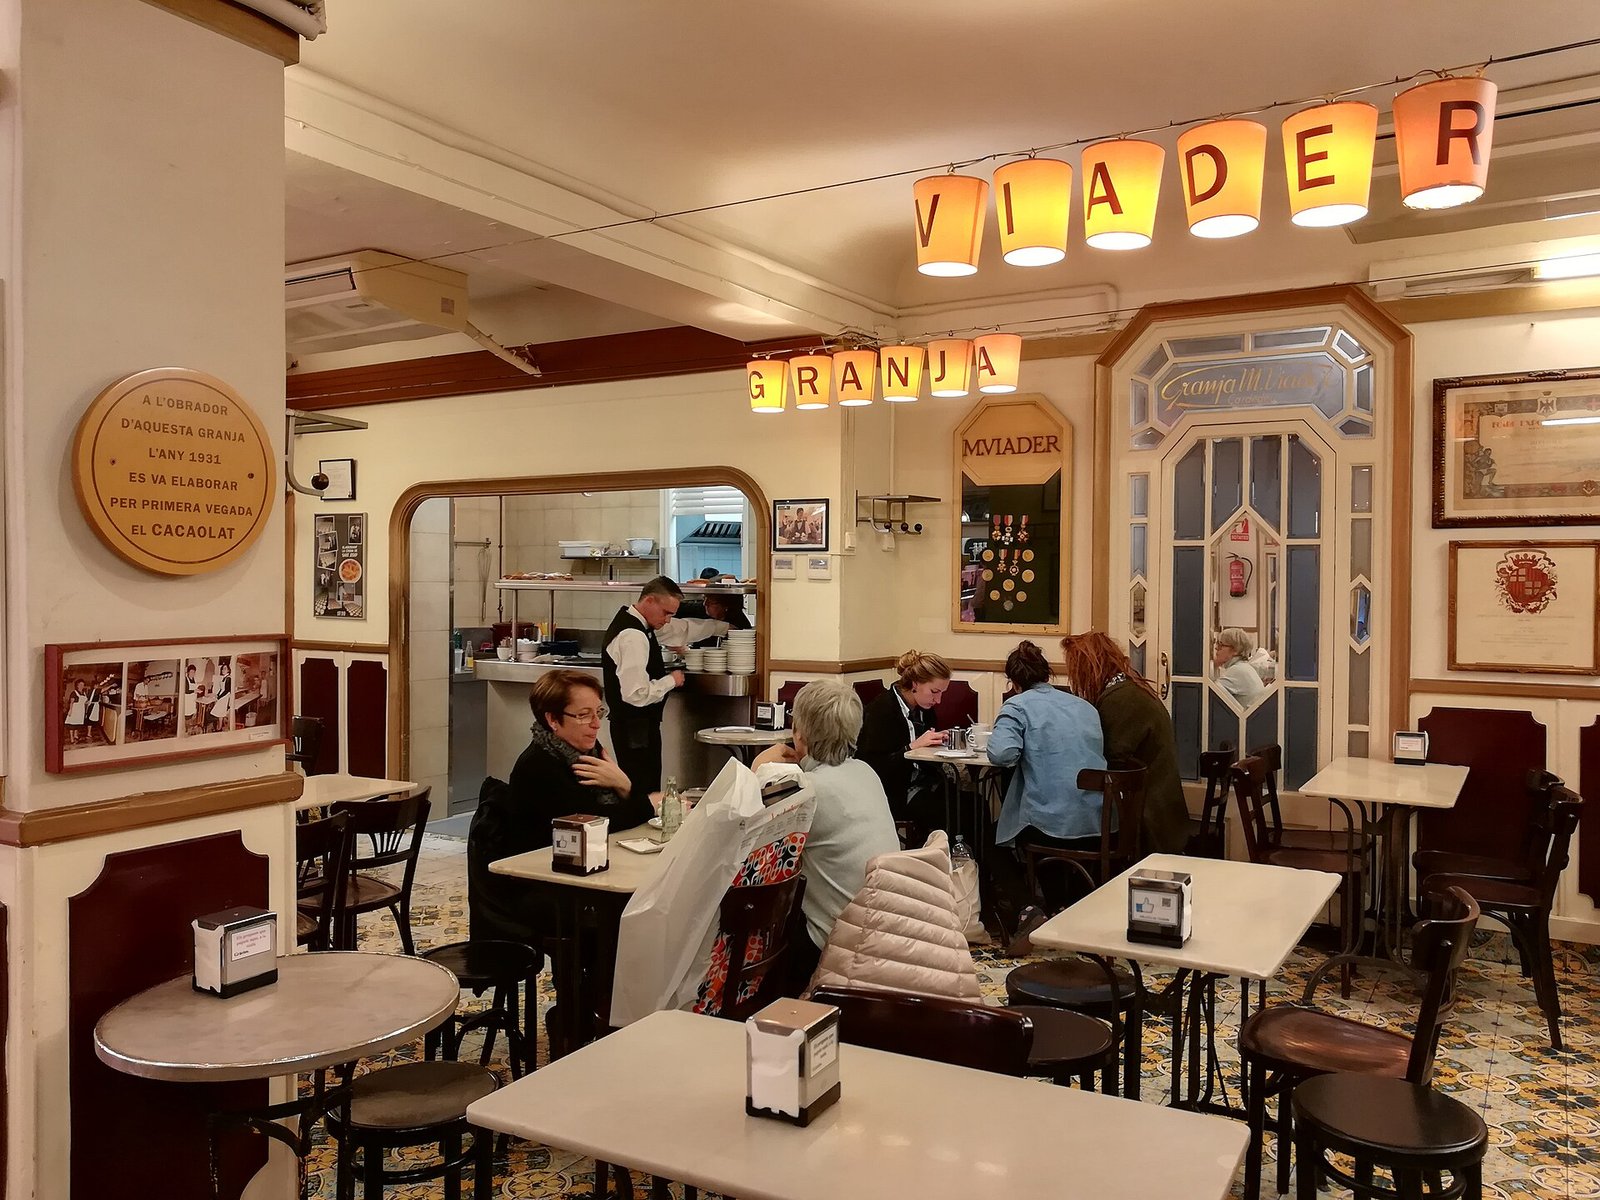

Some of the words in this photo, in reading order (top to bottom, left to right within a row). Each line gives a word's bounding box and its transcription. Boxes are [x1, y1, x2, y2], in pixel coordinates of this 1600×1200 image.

[914, 100, 1484, 248] VIADER
[748, 345, 997, 400] GRANJA
[1160, 363, 1235, 408] Granja
[142, 394, 151, 406] A
[156, 396, 228, 416] L'OBRADOR
[121, 417, 194, 437] D'AQUESTA
[198, 427, 246, 443] GRANJA
[148, 447, 185, 461] L'ANY
[189, 452, 222, 465] 1931
[129, 472, 146, 483] ES
[151, 473, 167, 485] VA
[171, 476, 238, 491] ELABORAR
[110, 497, 137, 509] PER
[141, 499, 201, 513] PRIMERA
[206, 503, 253, 517] VEGADA
[131, 524, 147, 536] EL
[151, 523, 235, 540] CACAOLAT
